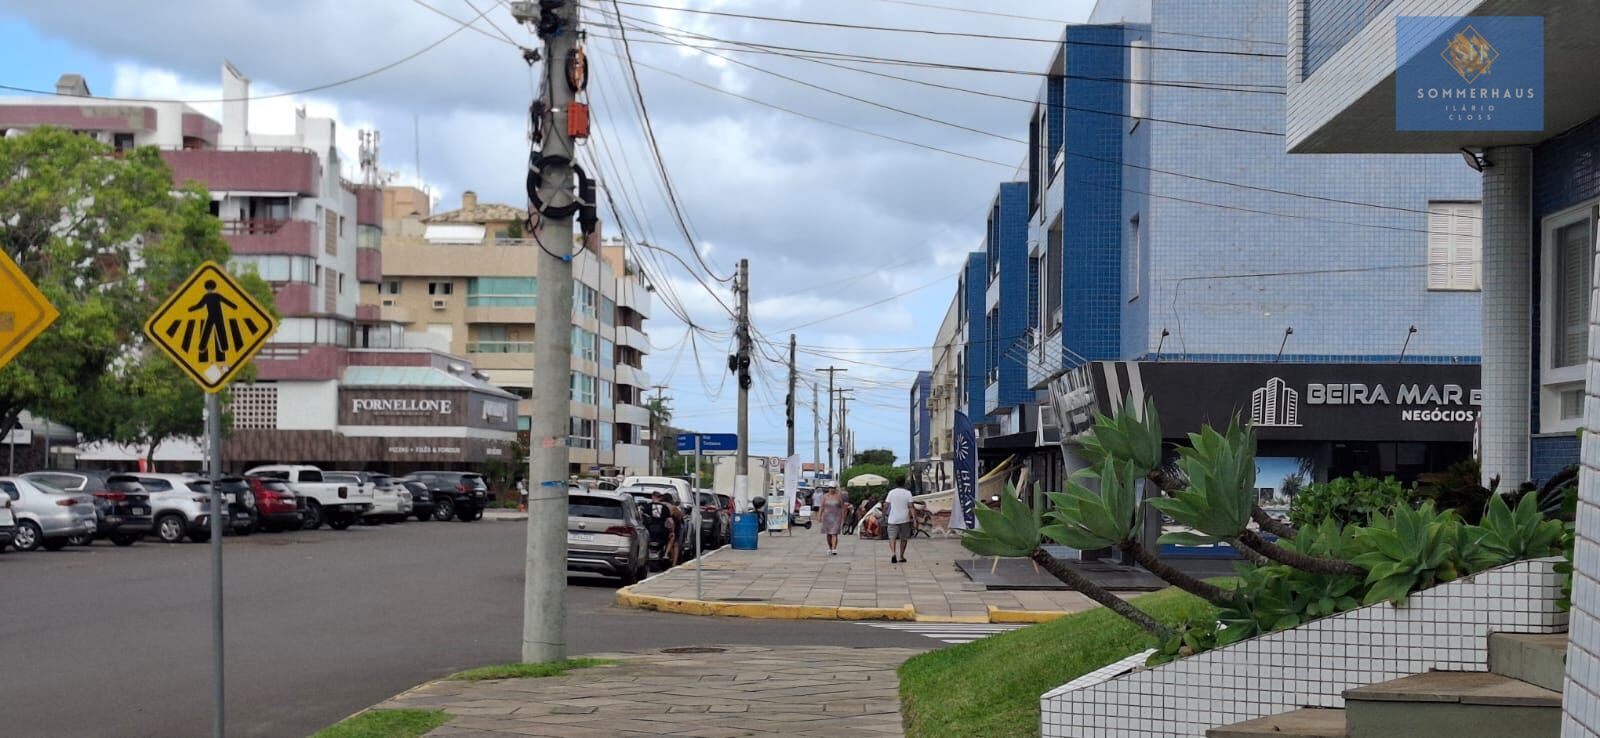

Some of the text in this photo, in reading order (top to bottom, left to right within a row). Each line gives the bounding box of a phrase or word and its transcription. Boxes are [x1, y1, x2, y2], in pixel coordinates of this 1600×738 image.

[1306, 383, 1390, 405] BEIRA
[1397, 383, 1464, 406] MAR
[352, 399, 452, 414] FORNELLONE
[1402, 408, 1474, 422] NEGÓCIOS
